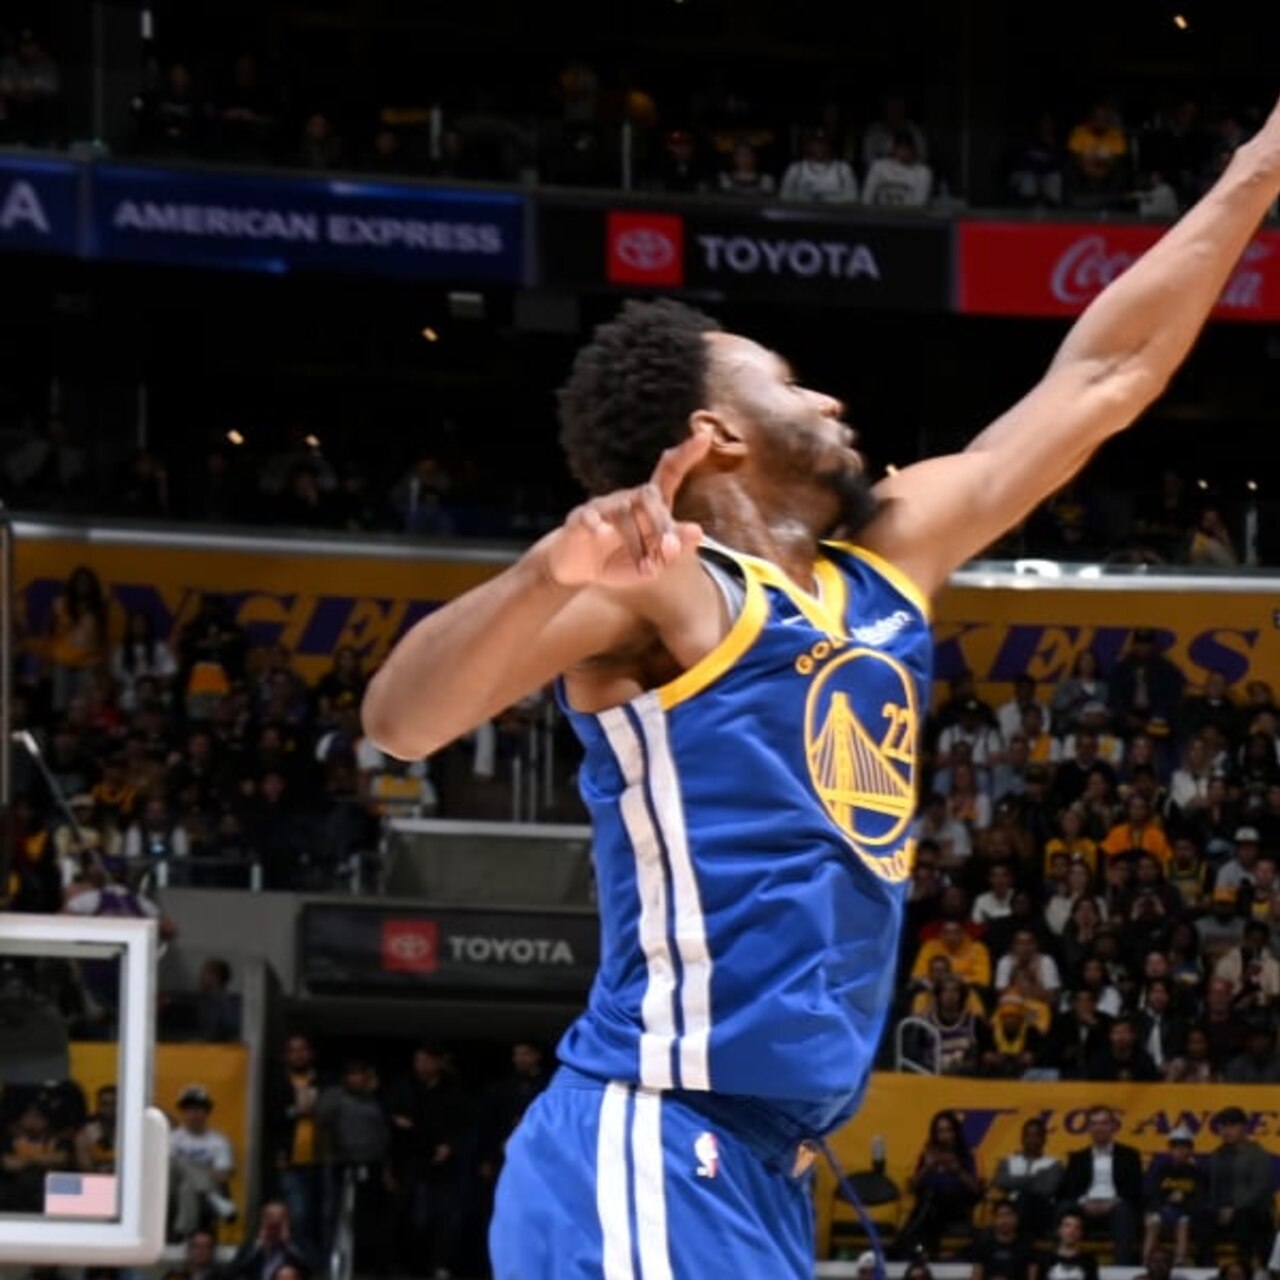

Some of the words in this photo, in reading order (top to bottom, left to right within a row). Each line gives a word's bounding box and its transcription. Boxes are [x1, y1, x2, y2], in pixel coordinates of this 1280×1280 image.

[114, 200, 317, 241] AMERICAN
[328, 212, 501, 254] EXPRESS
[699, 235, 880, 279] TOYOTA
[448, 935, 574, 966] TOYOTA
